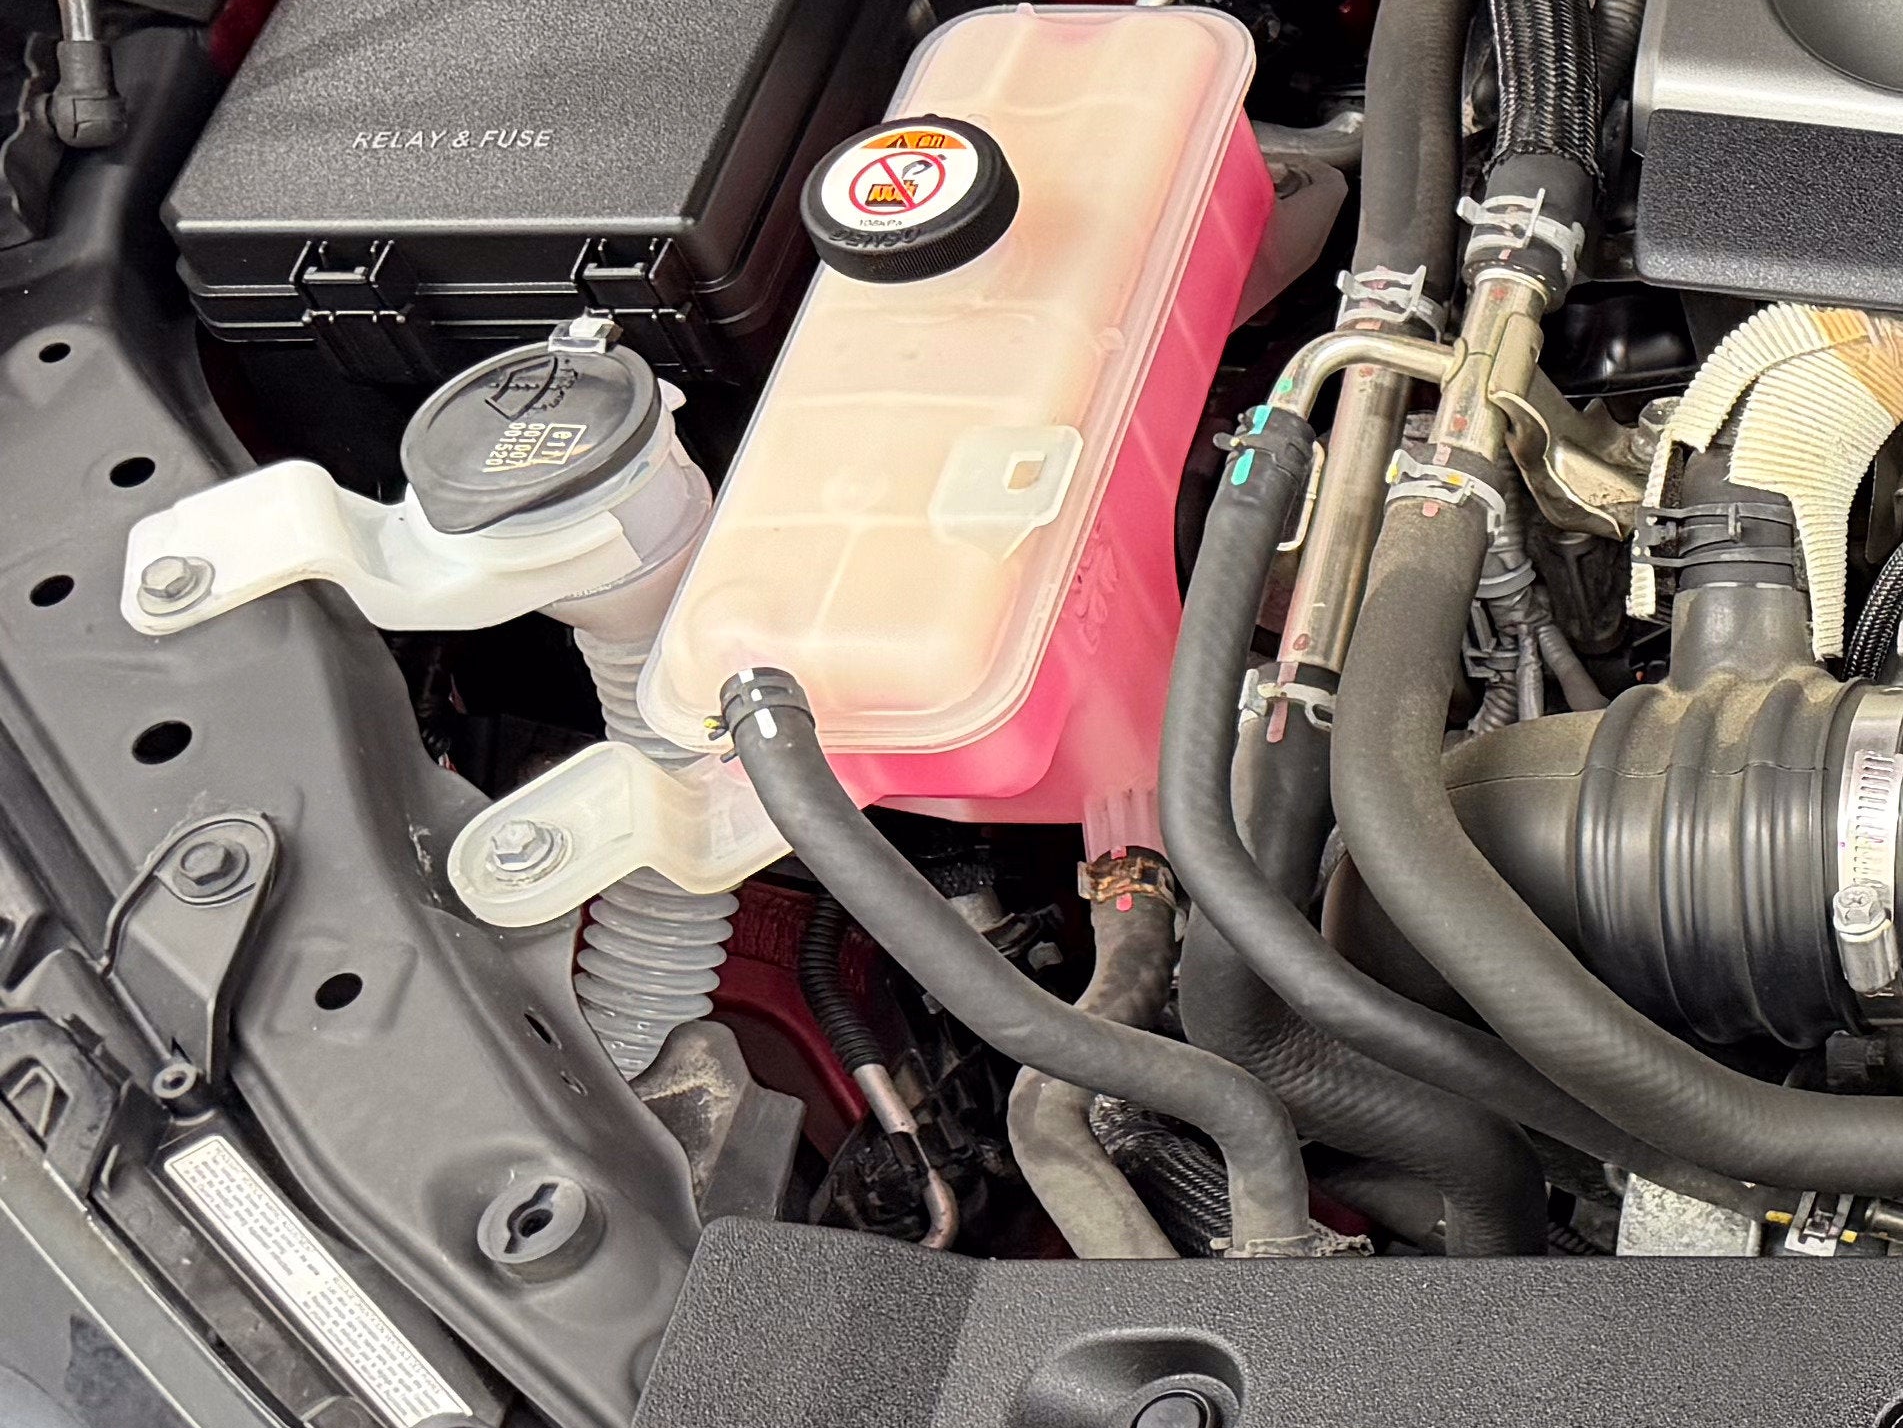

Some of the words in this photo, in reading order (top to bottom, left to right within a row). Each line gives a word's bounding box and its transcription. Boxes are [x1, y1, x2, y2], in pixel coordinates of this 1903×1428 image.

[353, 128, 446, 150] RELAY
[450, 128, 475, 149] &
[480, 128, 553, 150] FUSE
[829, 228, 922, 248] DENSO
